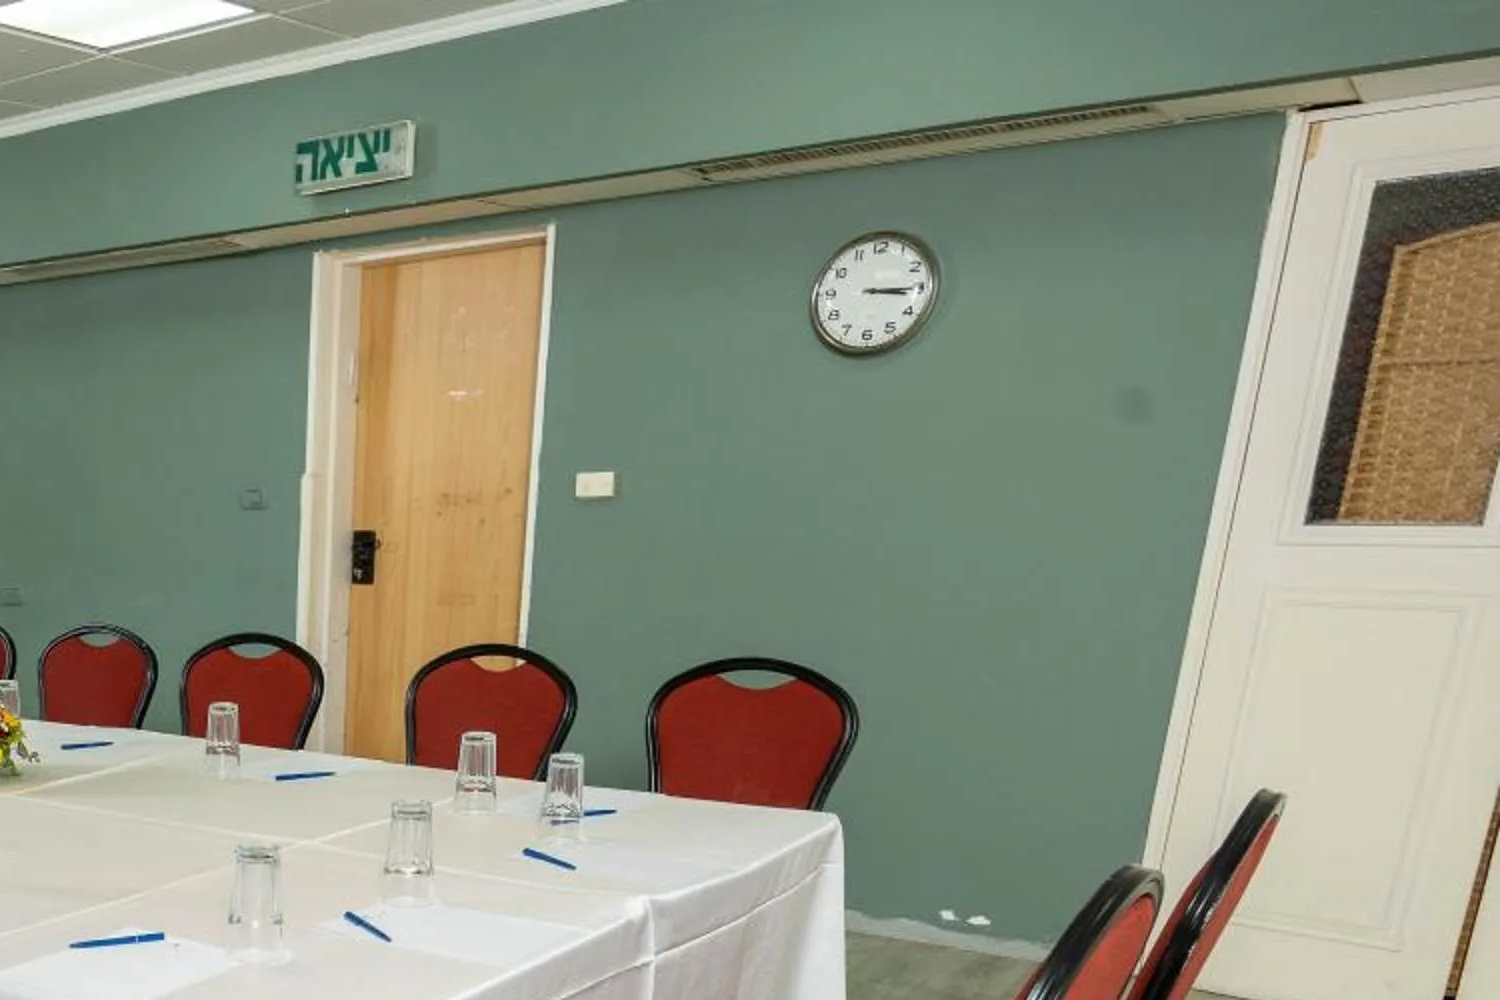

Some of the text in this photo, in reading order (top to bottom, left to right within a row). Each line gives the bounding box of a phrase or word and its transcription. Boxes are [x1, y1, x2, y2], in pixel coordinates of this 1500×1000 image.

[295, 128, 391, 184] יציאה
[873, 241, 889, 255] 12
[854, 249, 864, 261] 11
[909, 260, 921, 273] 2
[835, 267, 847, 279] 10
[825, 288, 836, 300] 9
[827, 309, 839, 321] 8
[902, 305, 913, 316] 4
[842, 324, 852, 336] 7
[884, 321, 896, 334] 5
[861, 329, 873, 341] 6
